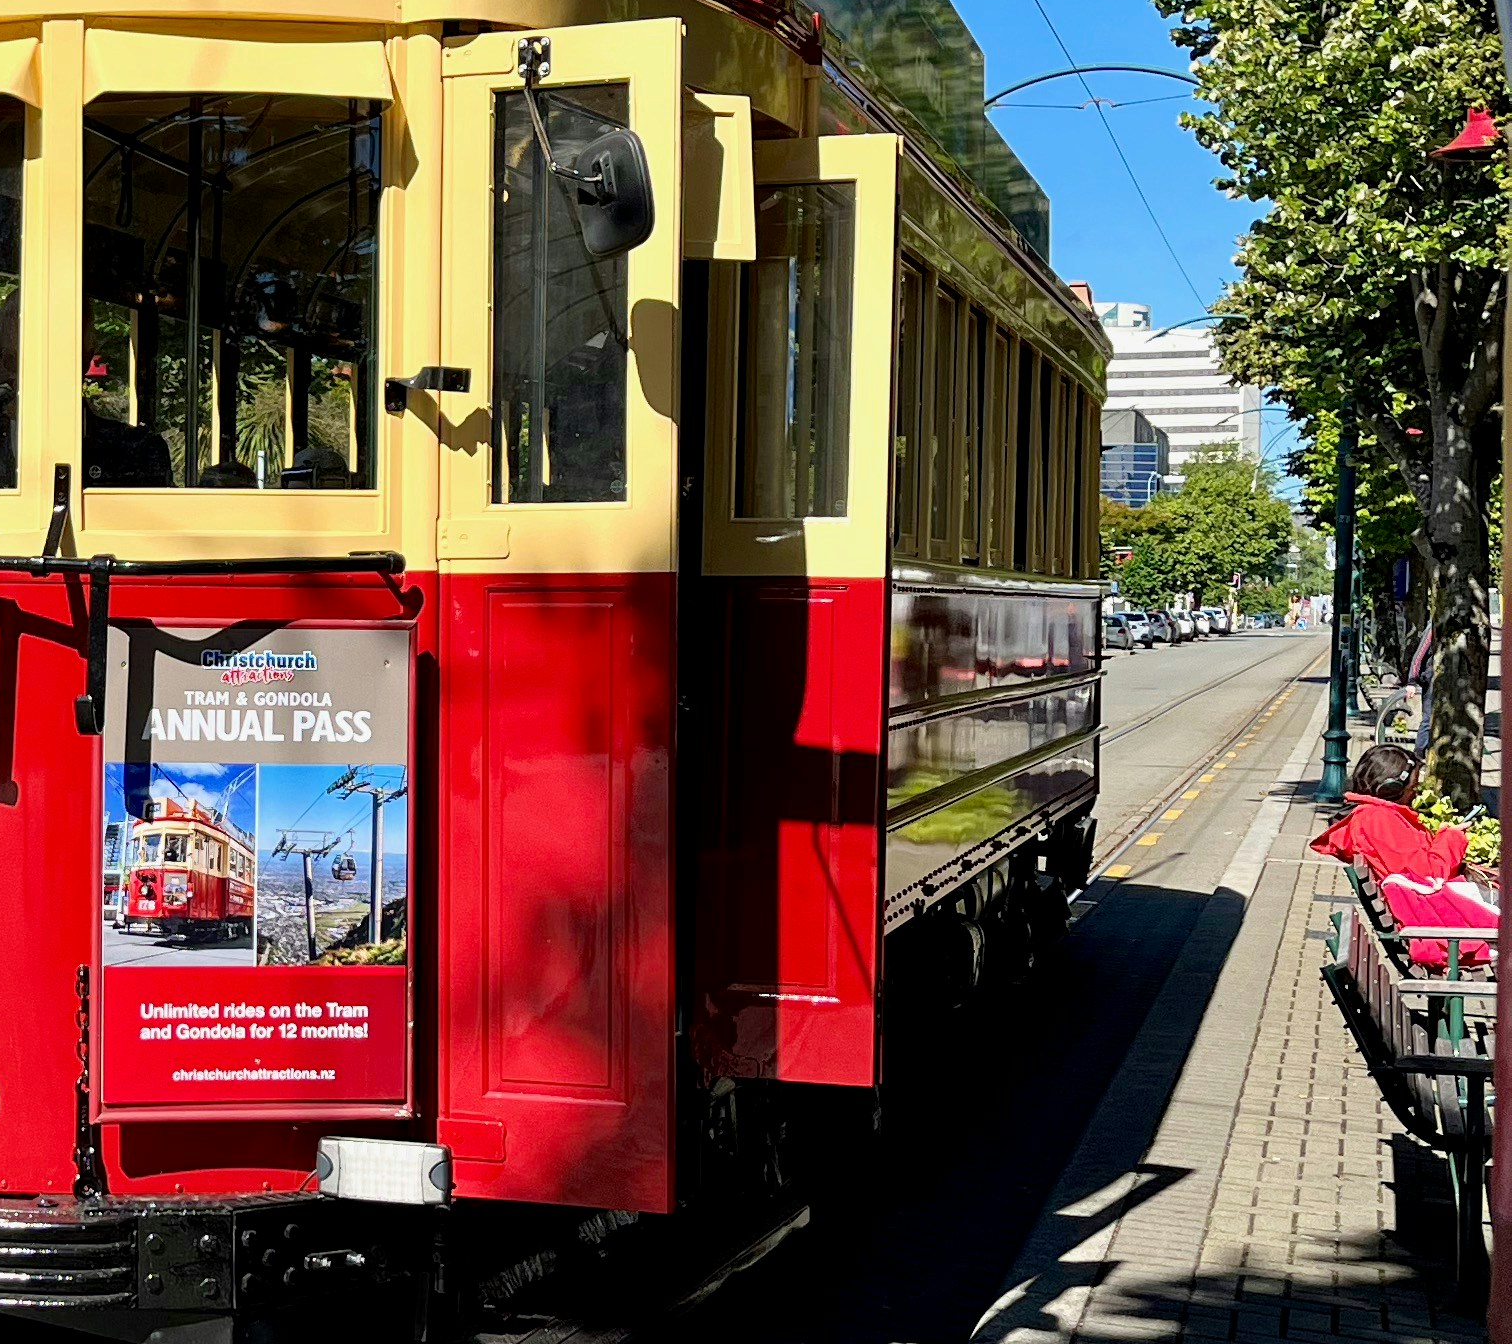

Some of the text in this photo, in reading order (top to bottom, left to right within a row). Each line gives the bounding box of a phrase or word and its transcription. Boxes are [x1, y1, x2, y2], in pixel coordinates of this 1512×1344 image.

[201, 650, 317, 670] Christchurch
[220, 666, 294, 686] attractions
[184, 691, 332, 707] TRAM & GONDOLA
[141, 708, 372, 743] ANNUAL PASS
[140, 1002, 369, 1019] Unlimited rides on the Tram
[140, 1023, 369, 1040] and Gondola for 12 months!
[172, 1067, 336, 1081] christchurchattractions.nz
